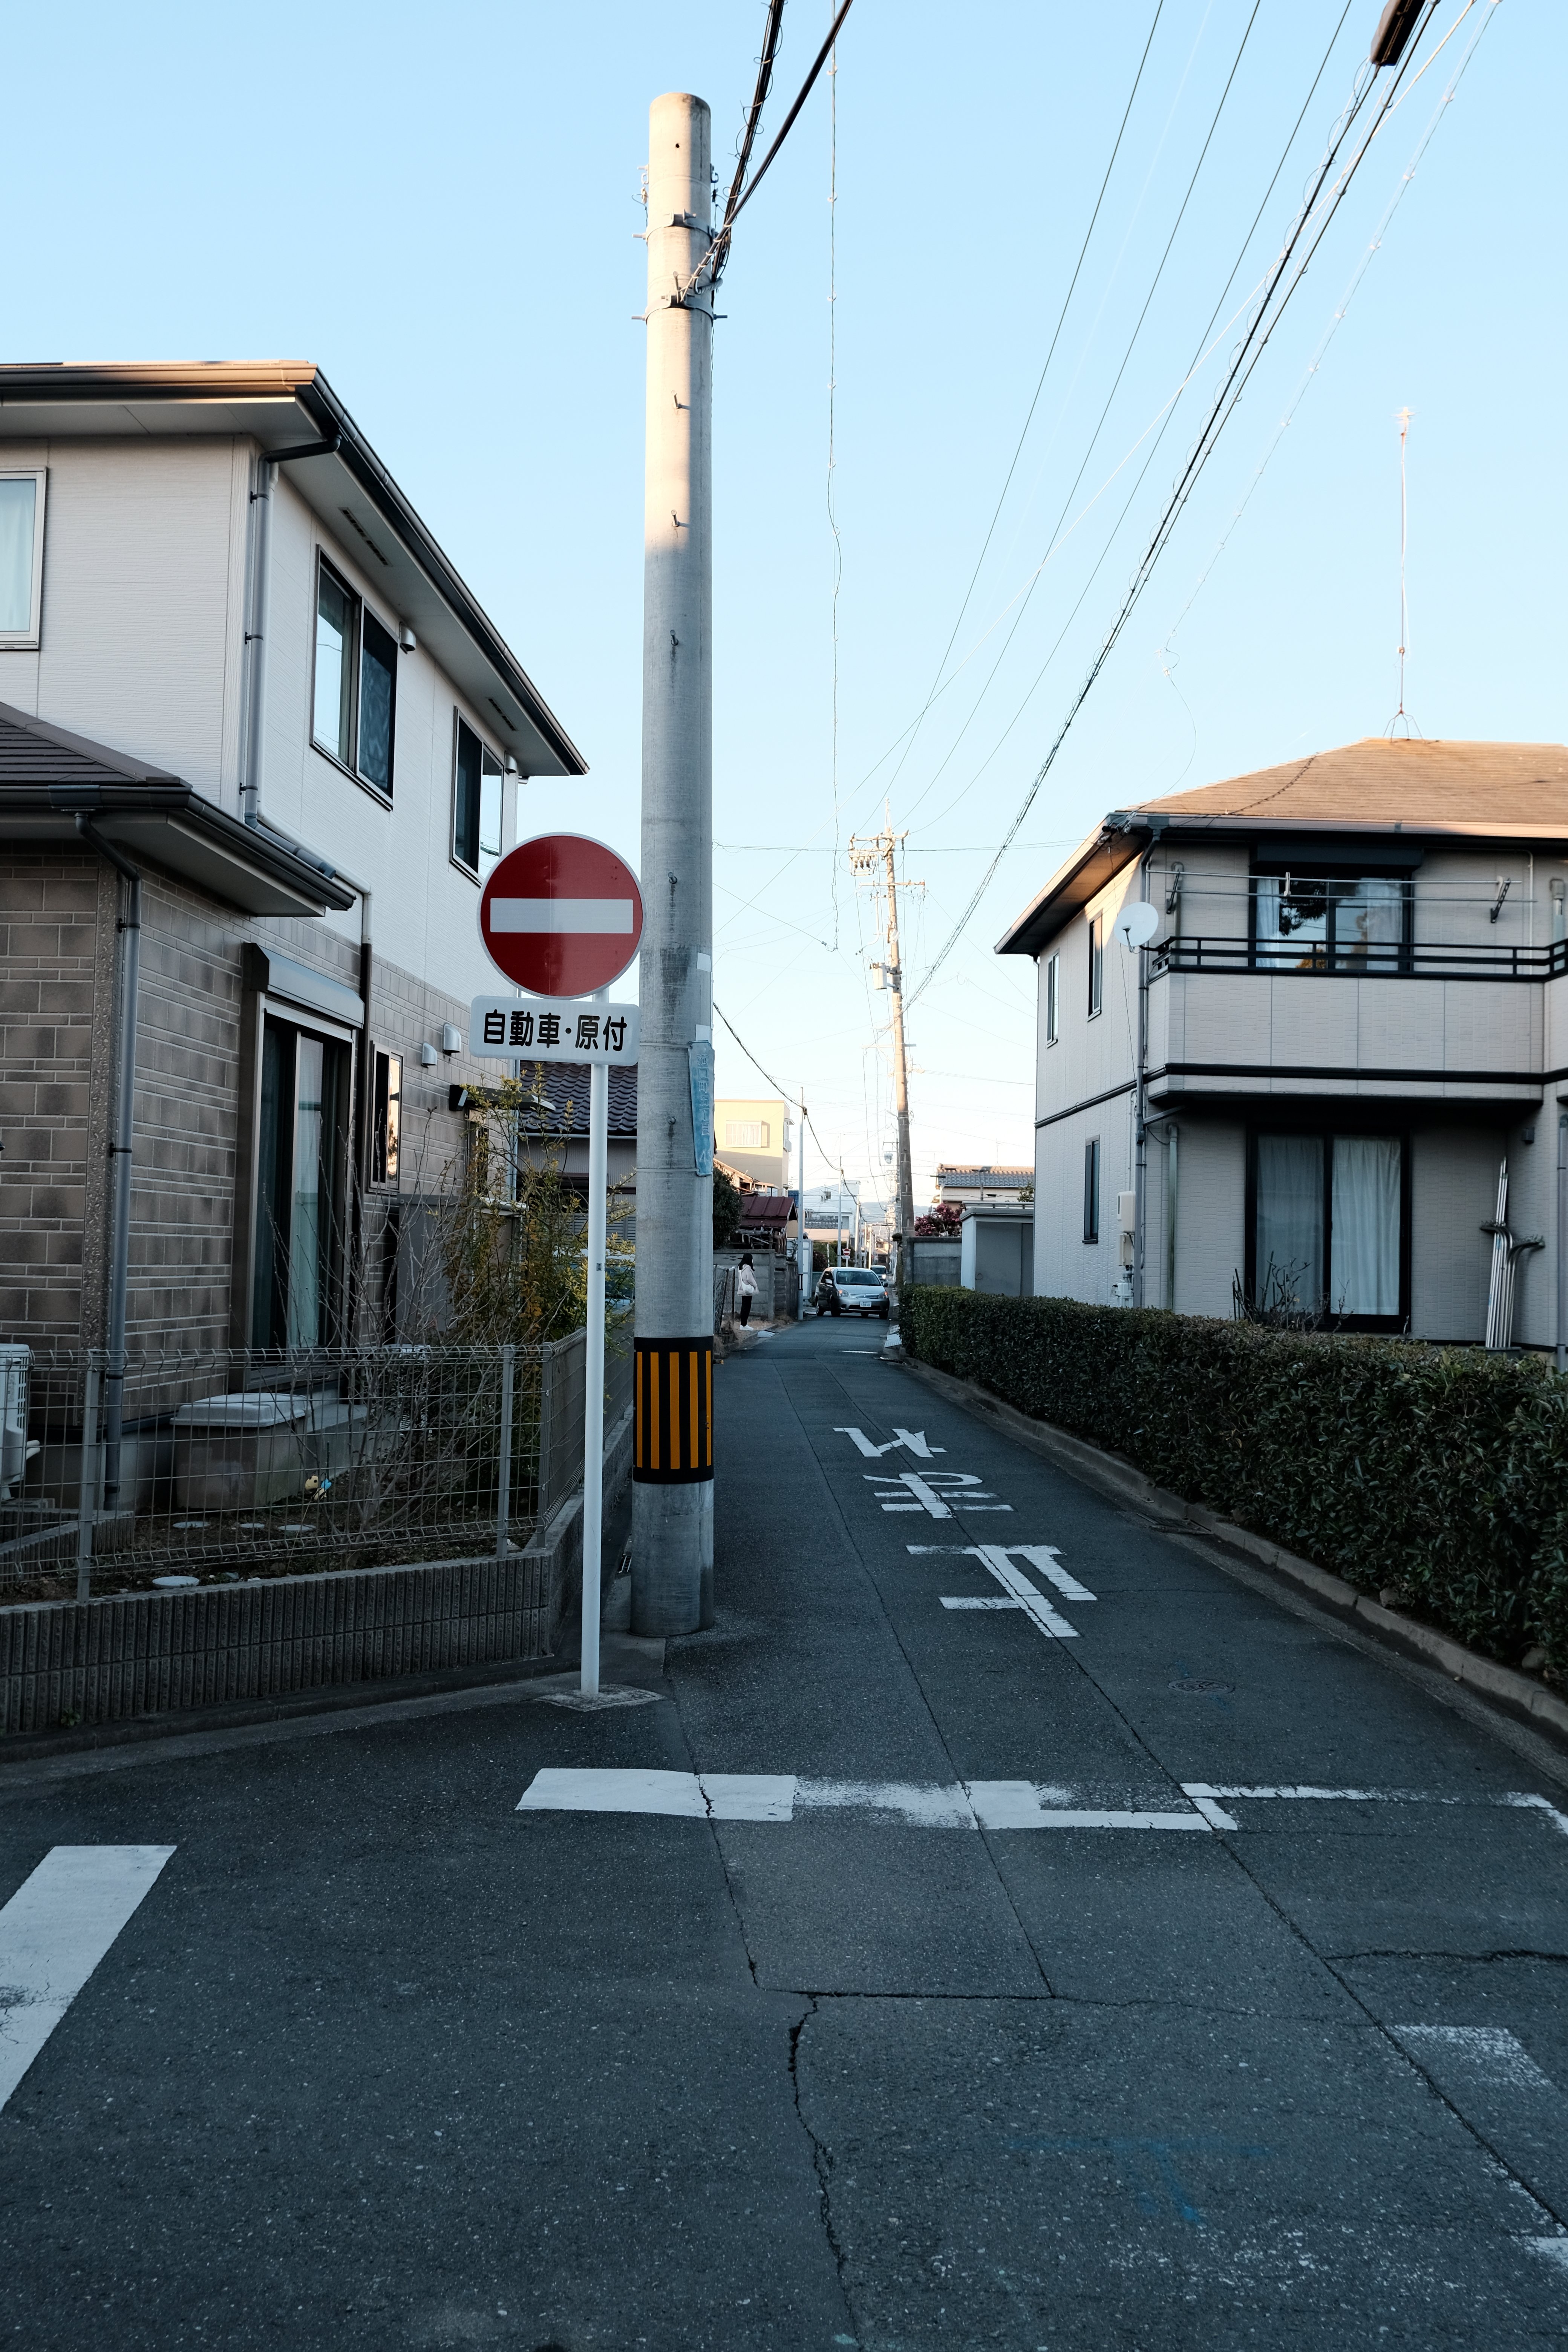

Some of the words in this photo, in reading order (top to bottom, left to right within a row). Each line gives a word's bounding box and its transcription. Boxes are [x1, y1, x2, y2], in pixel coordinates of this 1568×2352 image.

[483, 1009, 628, 1052] 自動車・原付
[832, 1427, 1098, 1638] 止まれ
